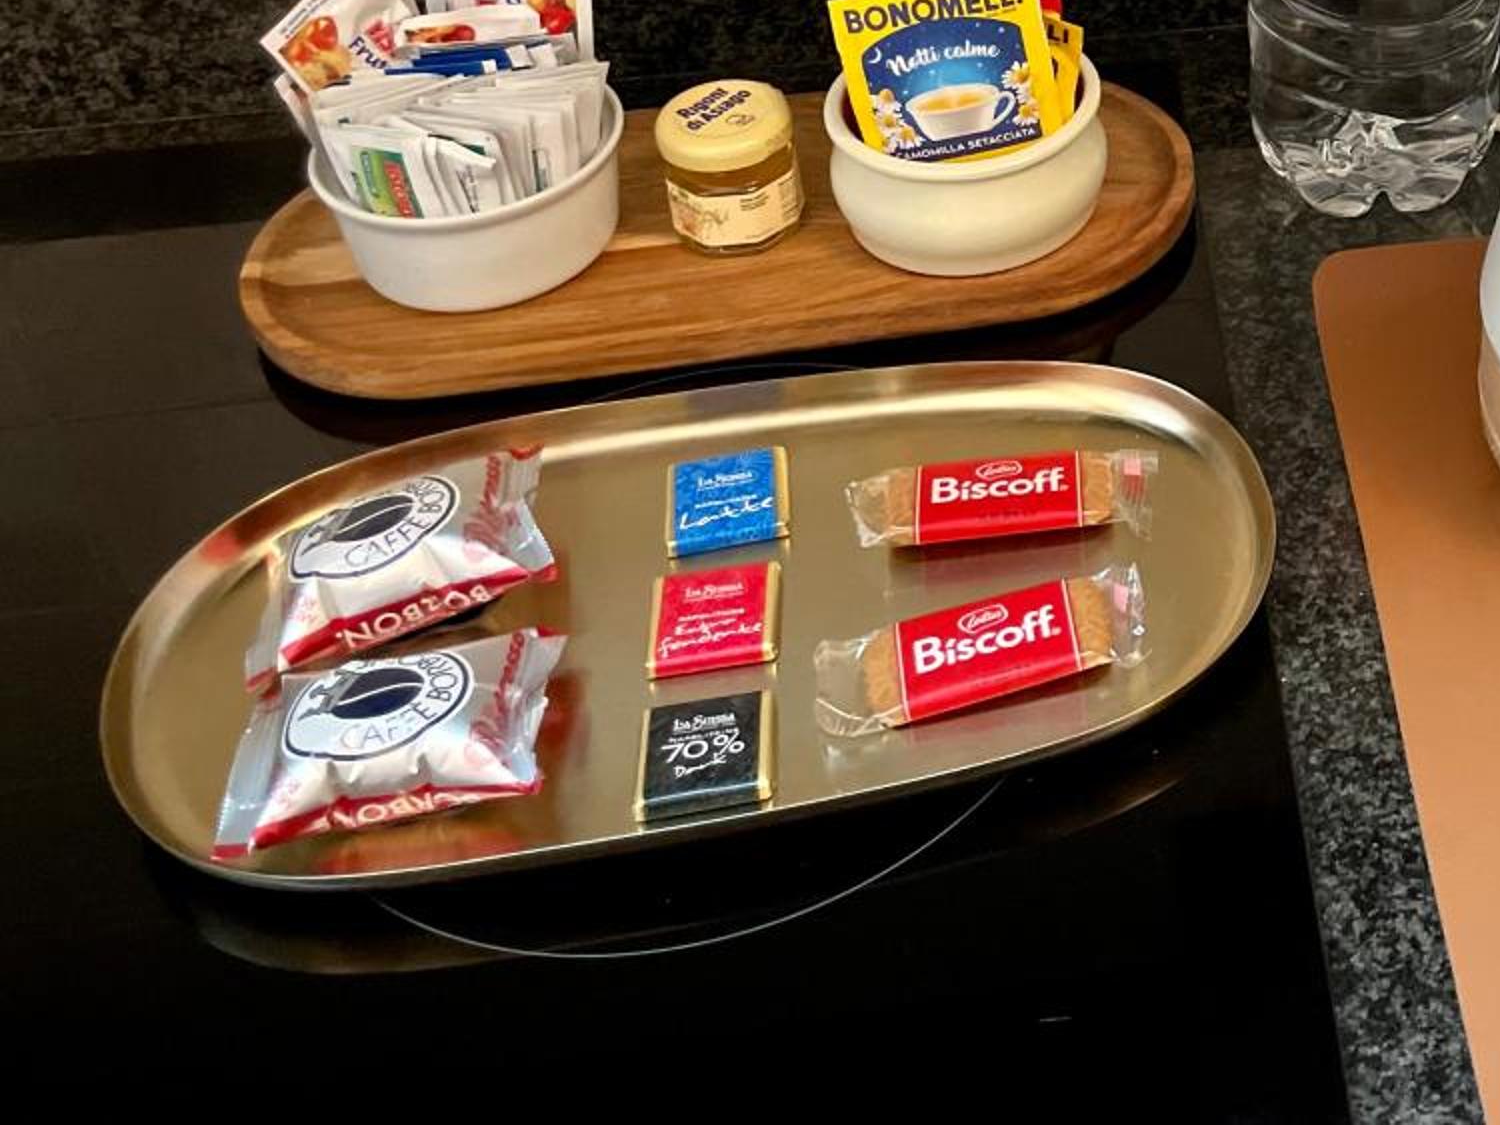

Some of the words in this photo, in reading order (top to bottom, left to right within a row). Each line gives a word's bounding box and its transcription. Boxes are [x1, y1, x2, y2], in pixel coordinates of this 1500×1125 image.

[943, 39, 1001, 59] calme
[931, 466, 1066, 505] Biscoff
[912, 604, 1058, 675] Biscoff
[660, 727, 745, 764] 70%
